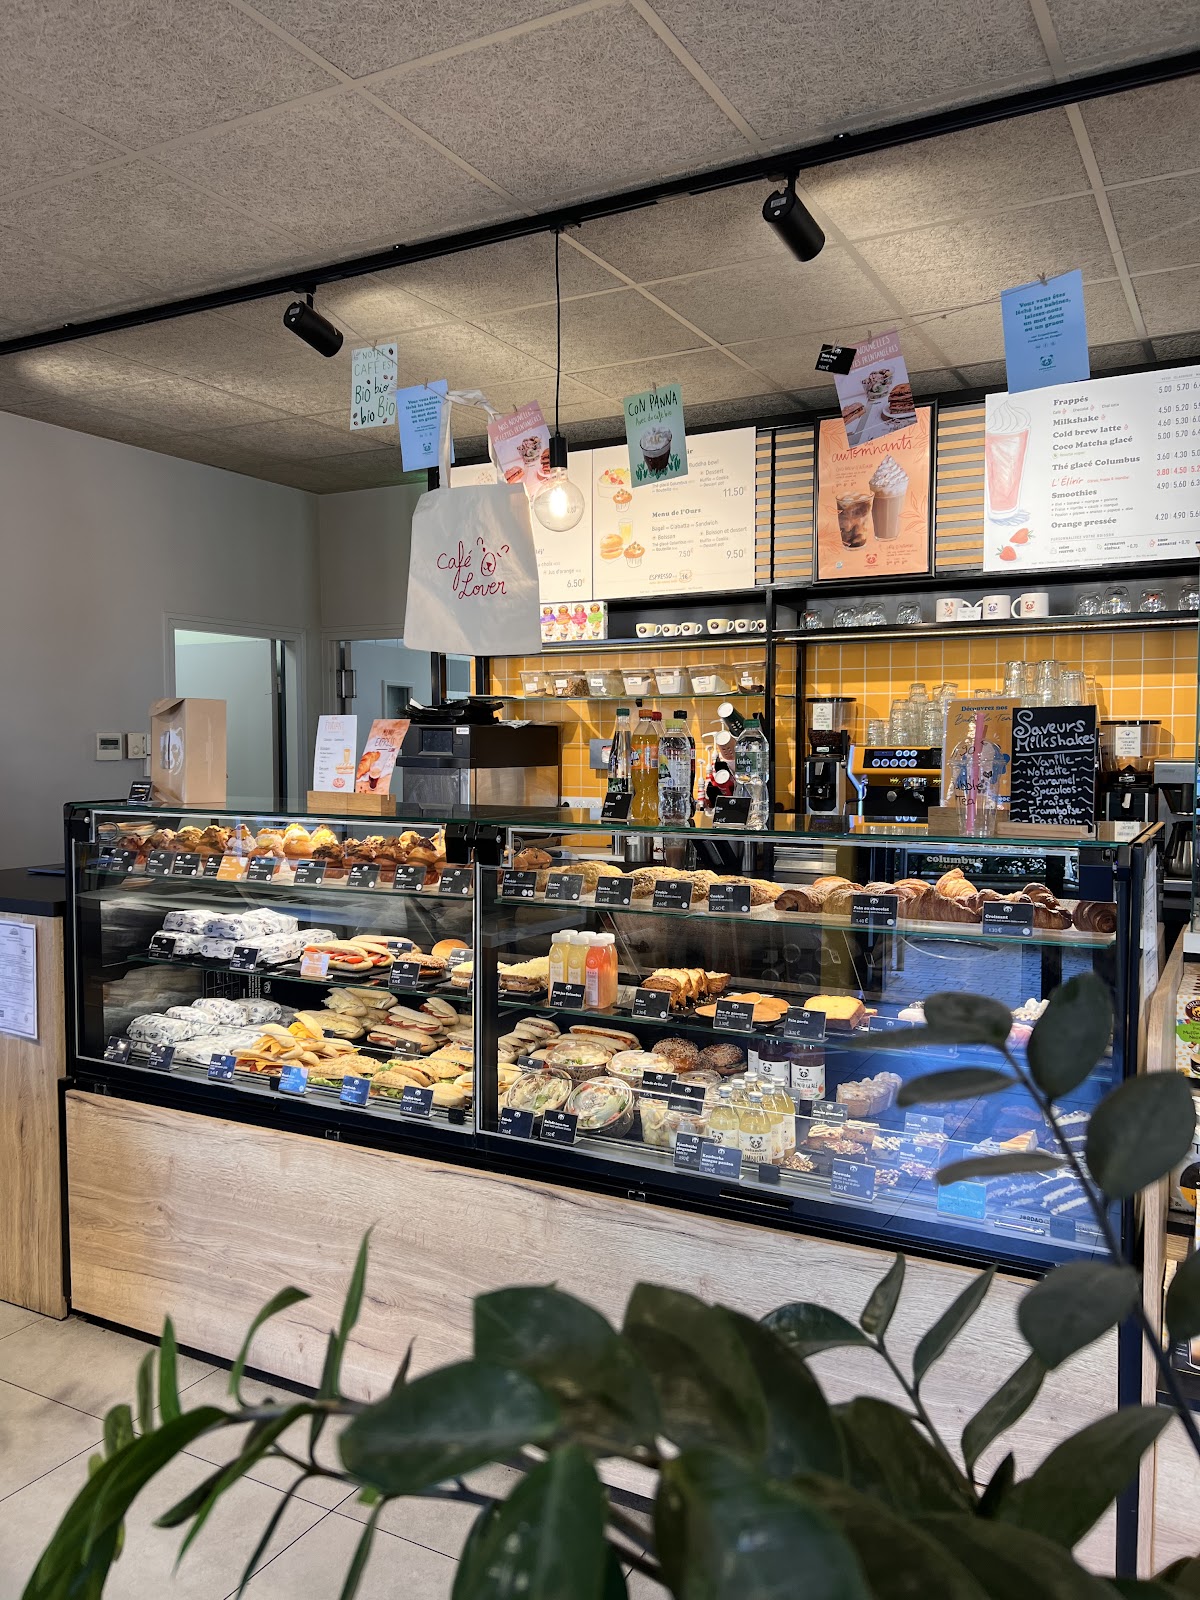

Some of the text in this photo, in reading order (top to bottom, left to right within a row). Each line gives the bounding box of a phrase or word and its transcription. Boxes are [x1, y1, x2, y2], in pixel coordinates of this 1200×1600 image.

[355, 377, 389, 404] Bio bio
[1158, 382, 1190, 394] 5.00 5.70
[649, 390, 678, 411] PANNA
[1053, 395, 1089, 406] Frappés
[361, 395, 395, 425] bio Bio
[1158, 403, 1189, 414] 4.50 5.20
[1053, 415, 1099, 426] Milkshake
[1158, 418, 1171, 427] 4.60
[1175, 416, 1189, 425] 5.30
[1053, 425, 1122, 439] Cold brew latte
[1157, 429, 1189, 440] 5.00 5.70
[1075, 439, 1108, 449] Matcha
[1110, 435, 1133, 446] glacé
[1157, 452, 1170, 461] 3.60
[1174, 450, 1188, 459] 4.30
[1052, 456, 1140, 471] Thé glacé Columbus
[1157, 468, 1170, 476] 3.80
[1174, 466, 1187, 474] 4.50
[1157, 482, 1170, 490] 4.90
[1173, 480, 1187, 489] 5.60
[1052, 489, 1097, 499] Smoothies
[1155, 511, 1186, 521] 4.20 4.90
[1051, 517, 1117, 529] Orange pressée
[437, 541, 473, 591] Café
[458, 572, 507, 600] Lover
[1013, 709, 1086, 738] Saveurs
[1014, 733, 1096, 752] Milkshakes
[1031, 754, 1075, 767] Vanille
[1027, 765, 1070, 777] Noisette
[1032, 773, 1076, 786] Caramel
[1031, 785, 1077, 797] Speculoos
[1035, 795, 1072, 806] Fraise
[1029, 805, 1082, 816] Framboise
[1029, 814, 1077, 825] Passion
[926, 855, 983, 867] columbus
[702, 1153, 725, 1161] Kombucha
